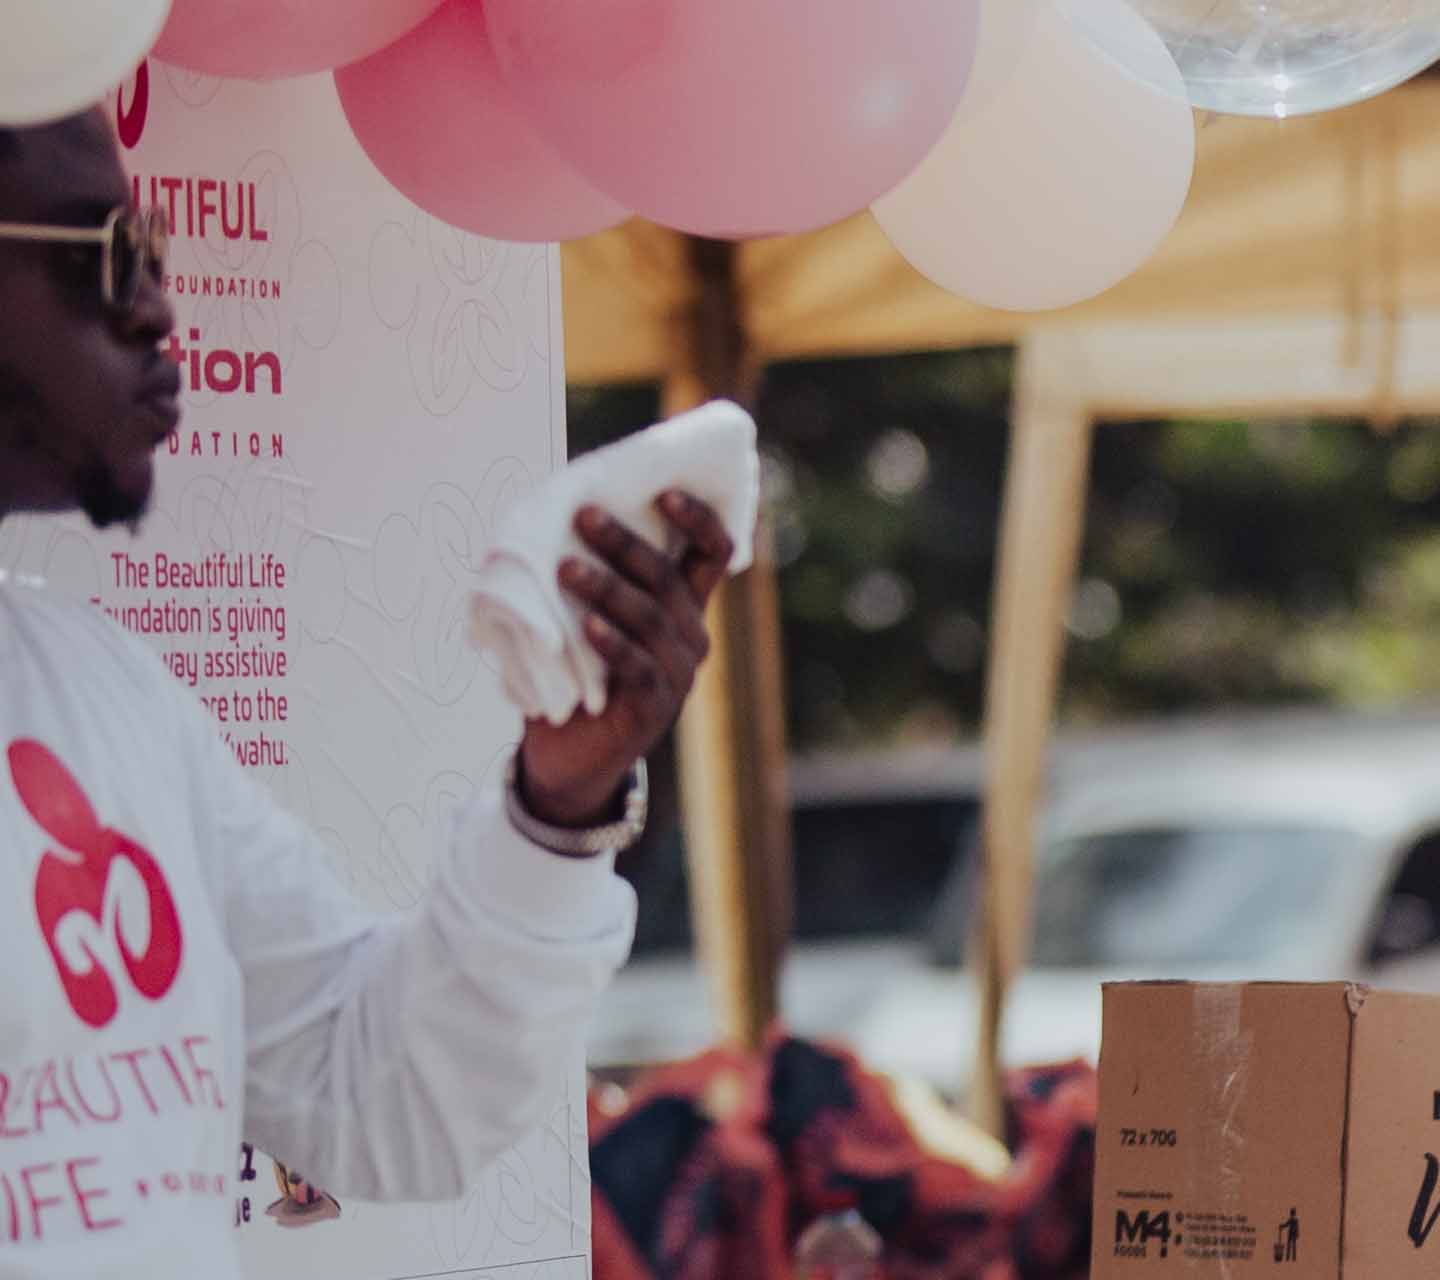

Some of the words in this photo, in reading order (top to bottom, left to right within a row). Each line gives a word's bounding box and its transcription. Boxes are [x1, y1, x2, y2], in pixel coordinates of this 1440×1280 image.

[111, 552, 150, 589] The
[154, 552, 244, 589] Beautiful
[248, 552, 287, 589] Life
[207, 598, 222, 633] is
[227, 597, 287, 641] giving
[204, 643, 288, 678] assistive
[232, 690, 252, 723] to
[256, 687, 289, 723] the
[1120, 1128, 1137, 1147] 72
[1114, 1209, 1173, 1244] M4
